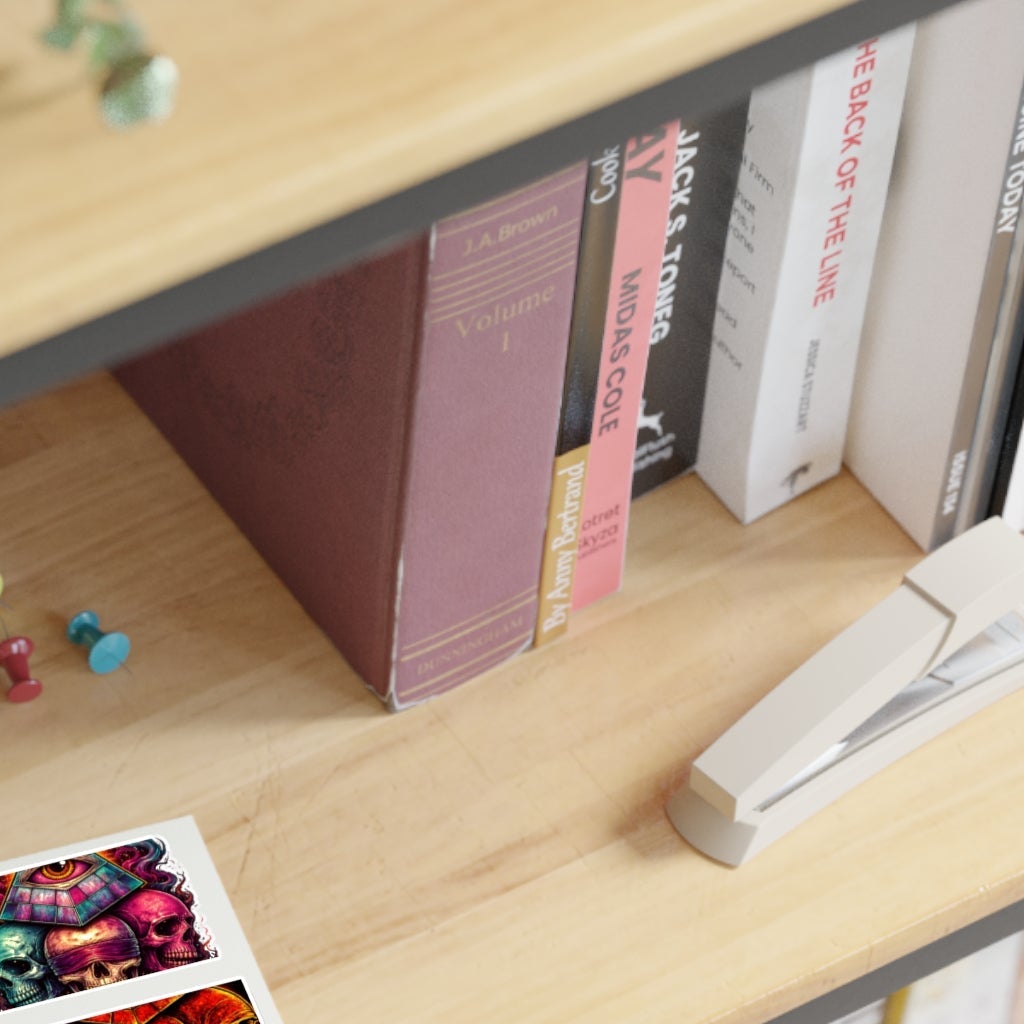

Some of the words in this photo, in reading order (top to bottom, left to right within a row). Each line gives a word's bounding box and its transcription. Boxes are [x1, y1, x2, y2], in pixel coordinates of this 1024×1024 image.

[841, 79, 873, 154] BACK
[668, 129, 701, 213] JACK
[834, 157, 860, 192] OF
[824, 194, 853, 250] THE
[812, 249, 842, 308] LINE
[456, 286, 556, 338] Volume
[608, 267, 643, 364] MIDAS
[598, 366, 627, 438] COLE
[551, 460, 585, 551] Bertrand
[542, 602, 573, 633] By
